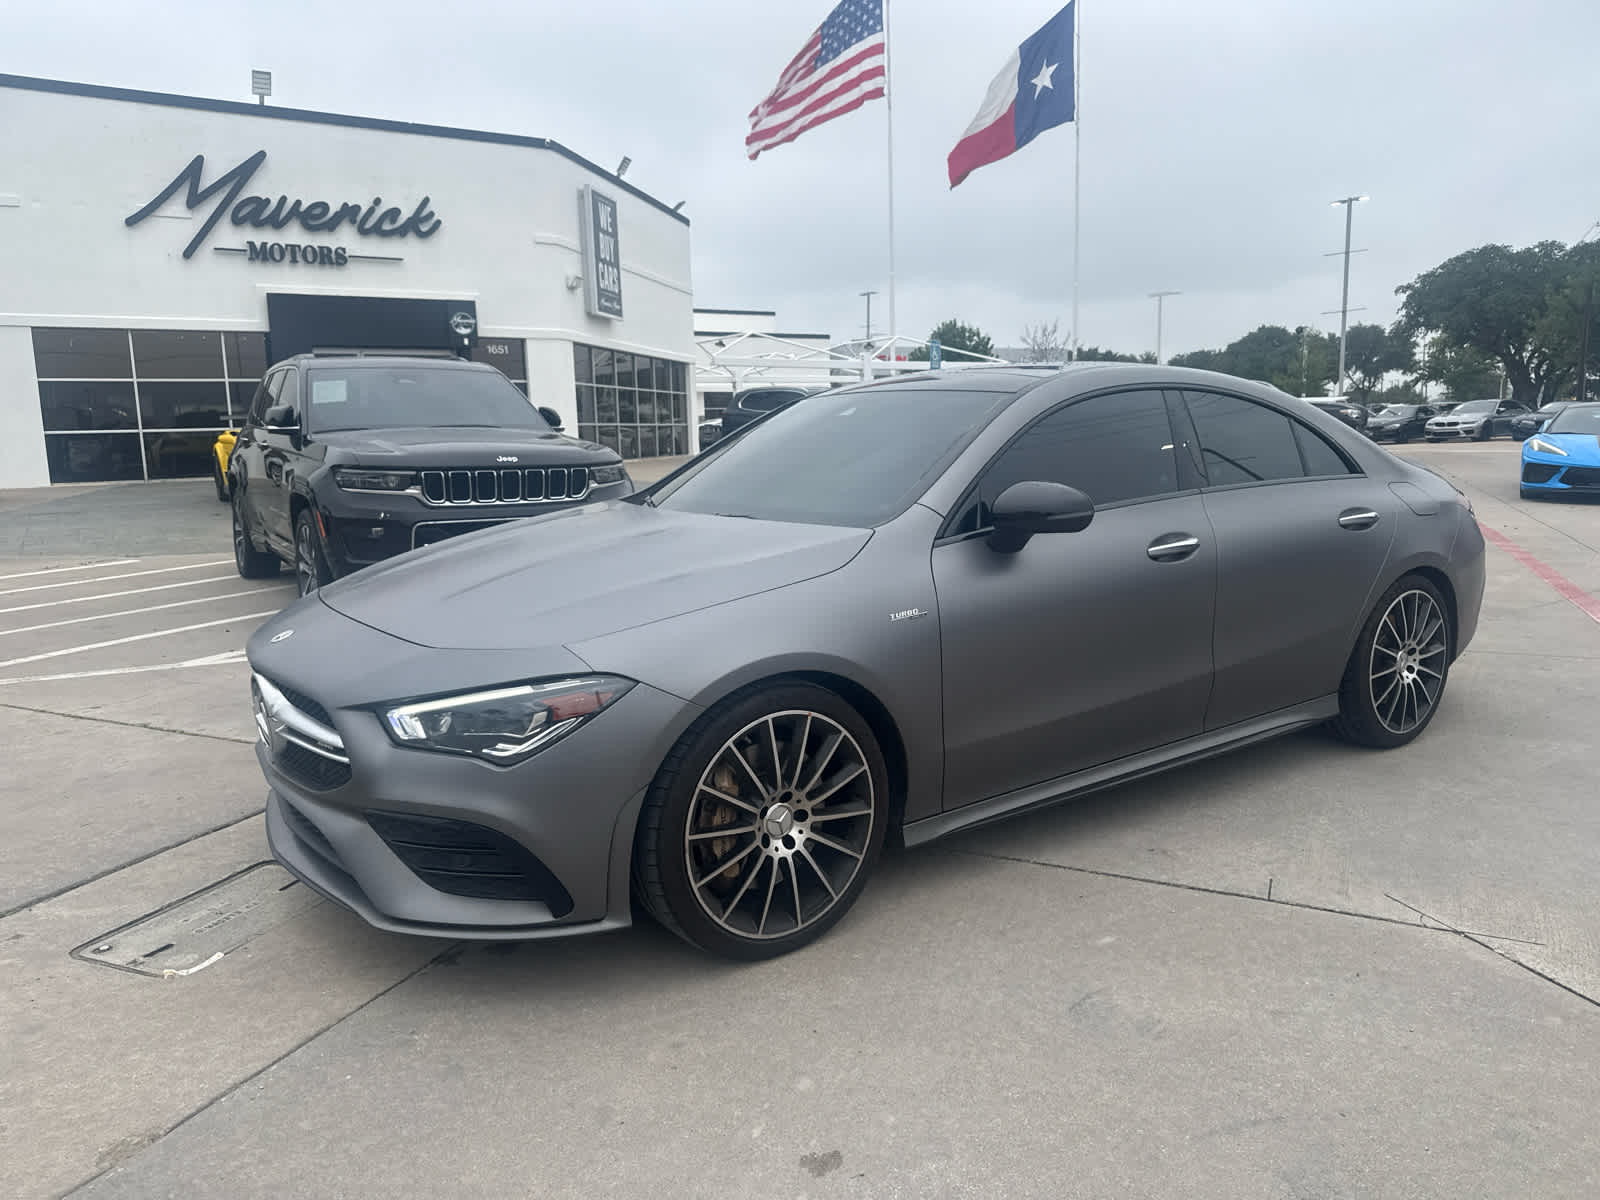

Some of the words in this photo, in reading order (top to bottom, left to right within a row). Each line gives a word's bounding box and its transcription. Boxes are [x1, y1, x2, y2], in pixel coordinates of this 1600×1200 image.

[125, 150, 442, 259] Maverick
[598, 201, 613, 232] WE
[246, 241, 348, 266] MOTORS
[600, 231, 615, 263] BUY
[599, 262, 619, 294] CARS
[487, 345, 509, 354] 1651
[496, 455, 518, 463] Jeep
[890, 608, 919, 620] TURBO
